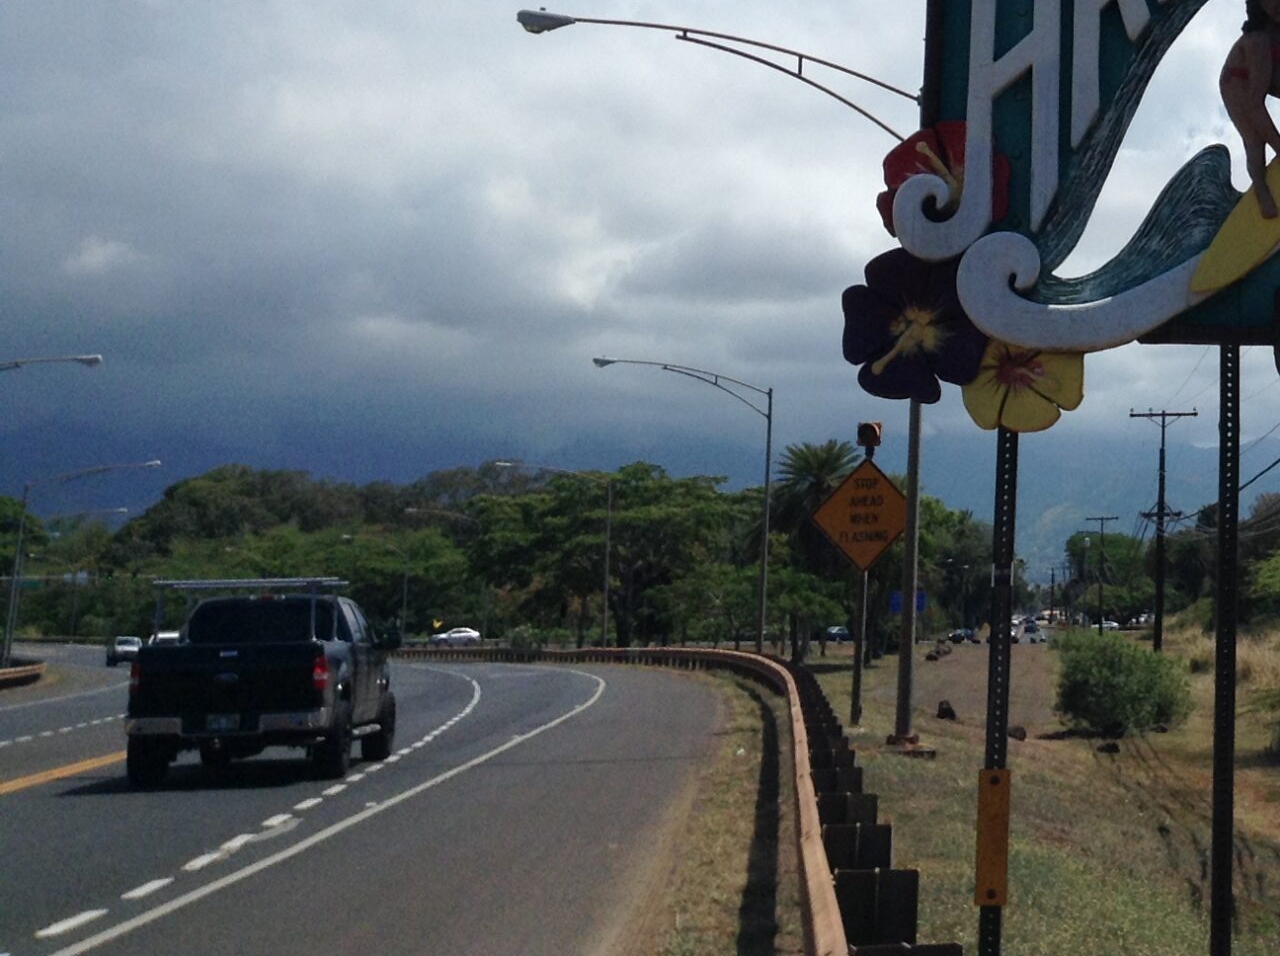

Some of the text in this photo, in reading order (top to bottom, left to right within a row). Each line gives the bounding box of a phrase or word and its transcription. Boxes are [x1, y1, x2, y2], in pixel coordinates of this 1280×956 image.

[854, 477, 880, 490] STOP
[849, 495, 884, 507] AHEAD
[850, 513, 879, 525] WHEN
[839, 531, 889, 543] FLASHING
